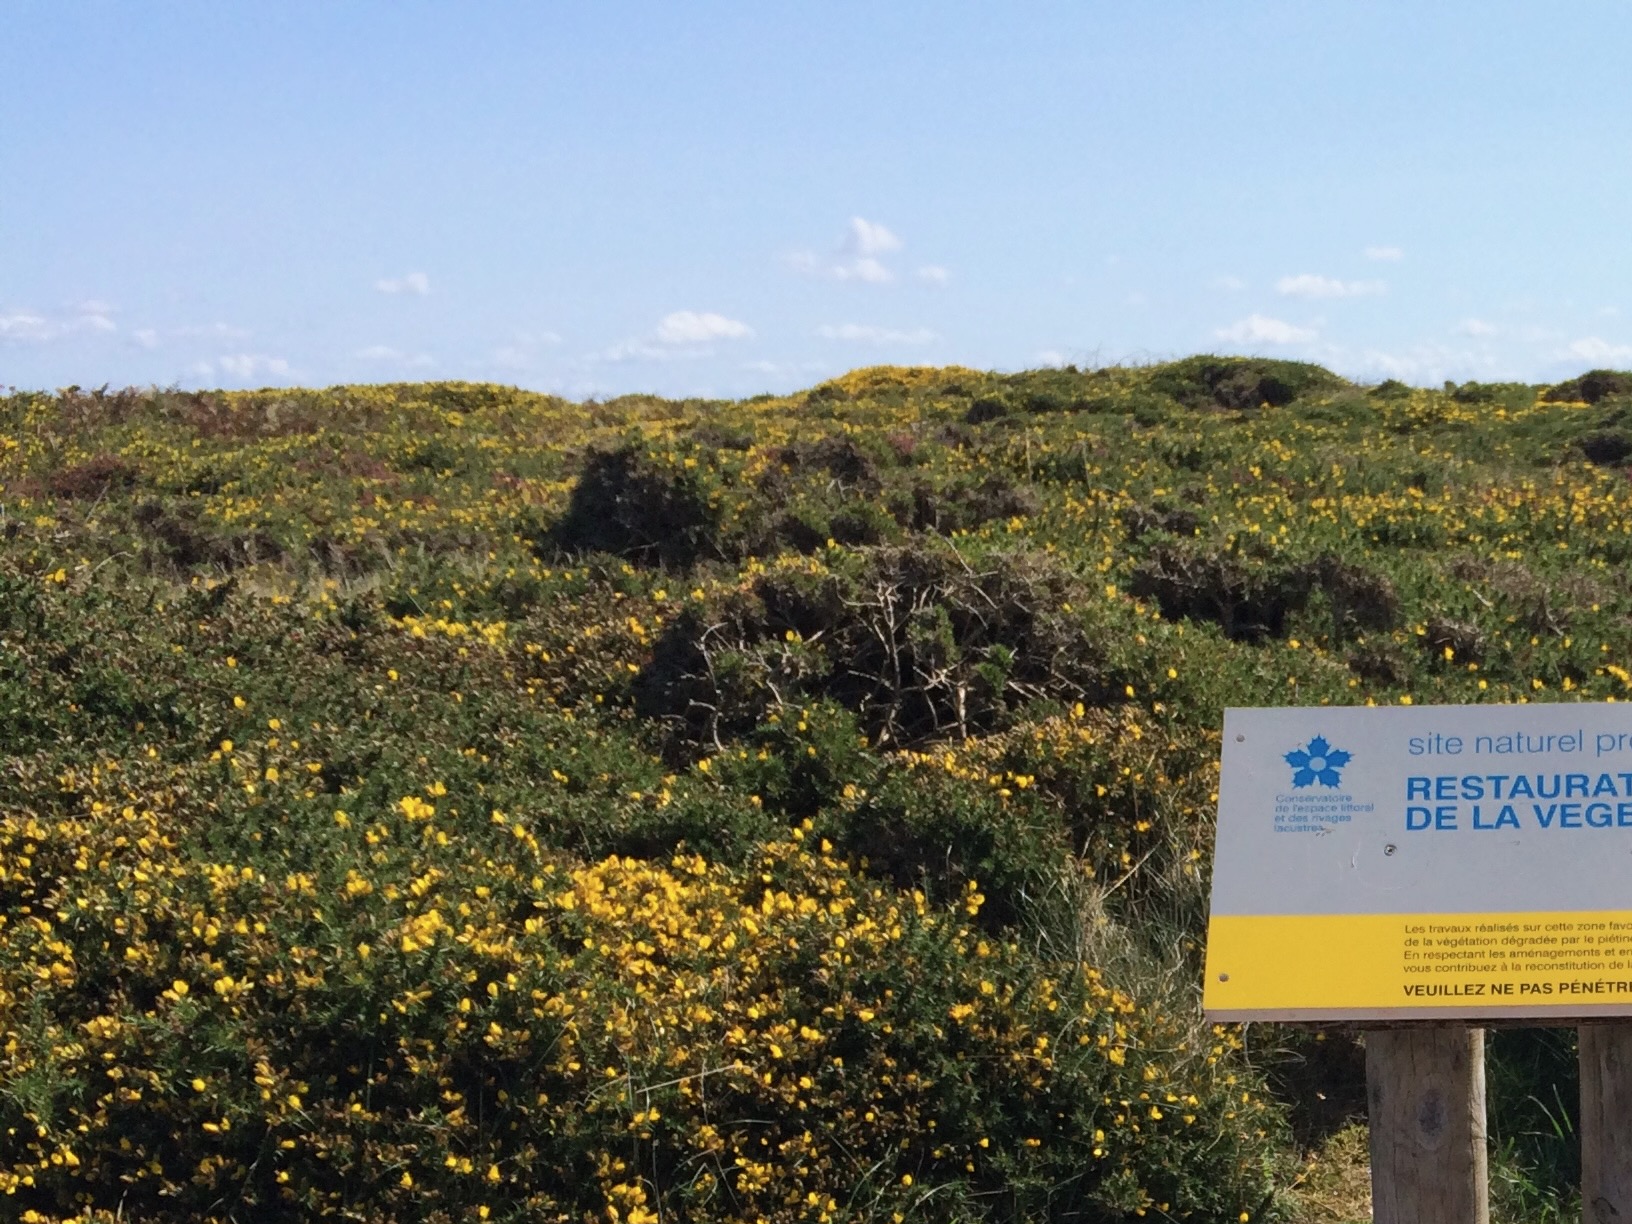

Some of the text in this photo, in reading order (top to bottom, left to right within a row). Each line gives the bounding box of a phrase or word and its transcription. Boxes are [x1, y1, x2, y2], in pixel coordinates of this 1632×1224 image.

[1408, 732, 1464, 755] site
[1475, 729, 1584, 754] naturel
[1276, 794, 1352, 802] Conservatoire
[1341, 803, 1374, 811] littoral
[1288, 814, 1308, 822] des
[1312, 814, 1352, 823] rivages
[1406, 805, 1458, 831] DE
[1473, 804, 1521, 830] LA
[1404, 925, 1426, 934] Les
[1429, 925, 1471, 933] travaux
[1475, 923, 1519, 932] réalisés
[1523, 924, 1541, 932] sur
[1545, 923, 1573, 931] cette
[1404, 938, 1419, 946] de
[1423, 937, 1433, 946] la
[1437, 937, 1498, 948] végétation
[1501, 936, 1557, 947] dégradée
[1561, 937, 1580, 946] par
[1404, 951, 1420, 960] En
[1423, 951, 1485, 961] respectant
[1489, 950, 1505, 958] les
[1509, 950, 1600, 959] aménagements
[1605, 948, 1615, 956] et
[1403, 964, 1431, 973] vous
[1435, 963, 1497, 972] contribuez
[1501, 962, 1508, 971] à
[1511, 962, 1521, 971] la
[1525, 961, 1605, 971] reconstitution
[1609, 961, 1624, 969] de
[1403, 984, 1485, 996] VEUILLEZ
[1491, 984, 1514, 995] NE
[1520, 983, 1553, 995] PAS
